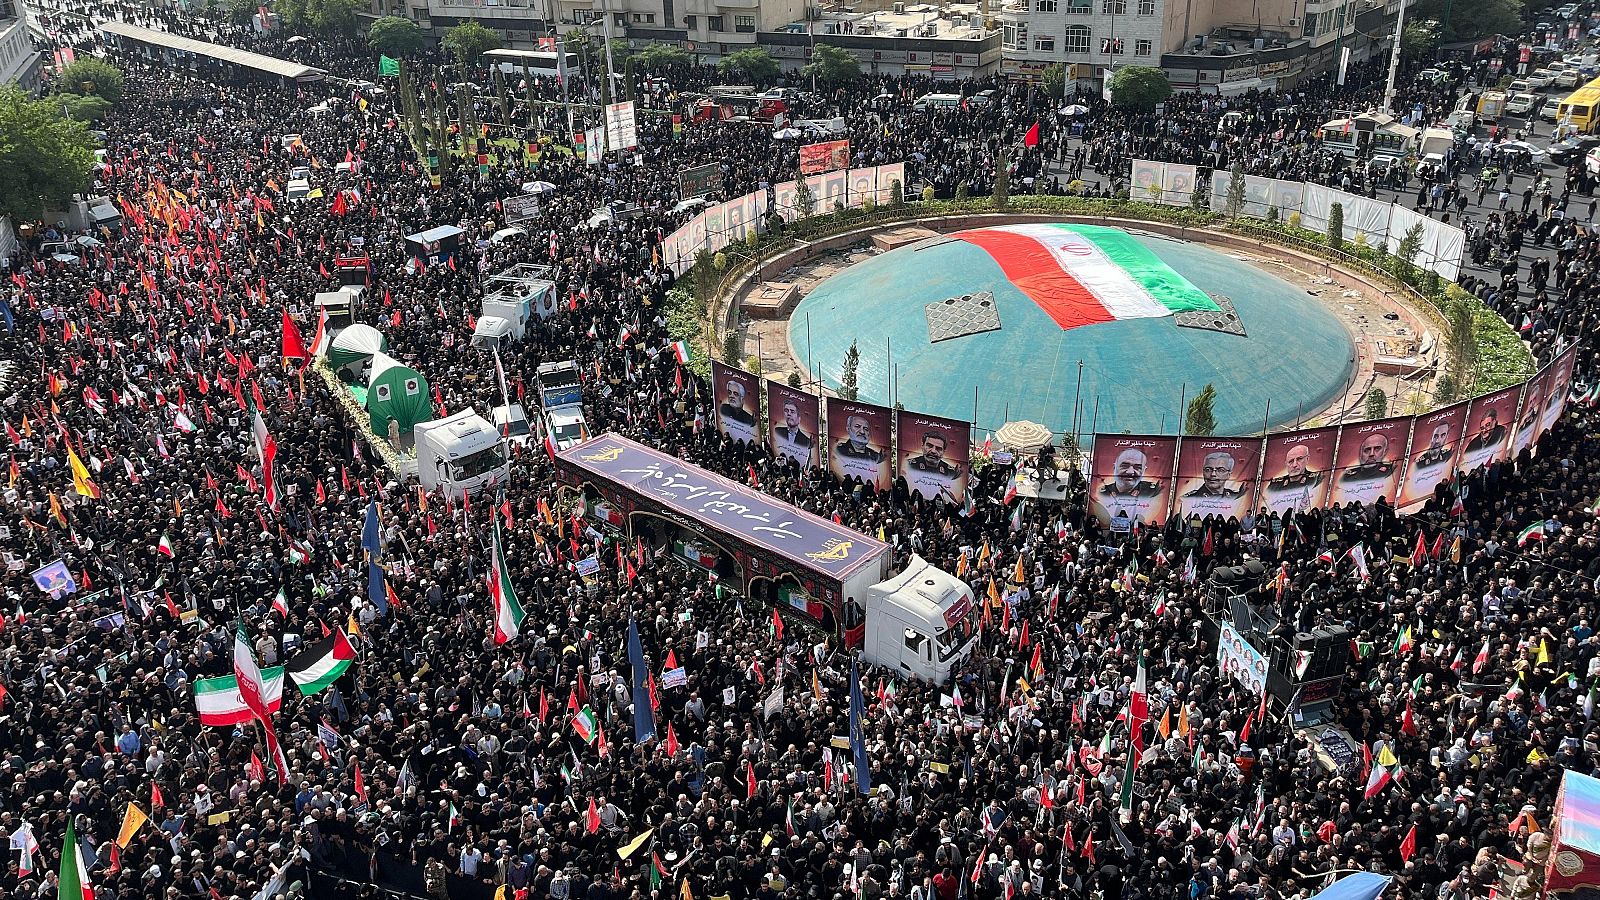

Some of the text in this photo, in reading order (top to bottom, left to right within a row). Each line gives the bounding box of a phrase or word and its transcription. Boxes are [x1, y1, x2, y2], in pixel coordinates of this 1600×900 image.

[939, 422, 951, 430] شهدا
[1358, 422, 1393, 433] شهدا مظهر اقتدار
[1283, 432, 1319, 444] شهدا مظهر اقتدار
[620, 462, 664, 479] سپاه
